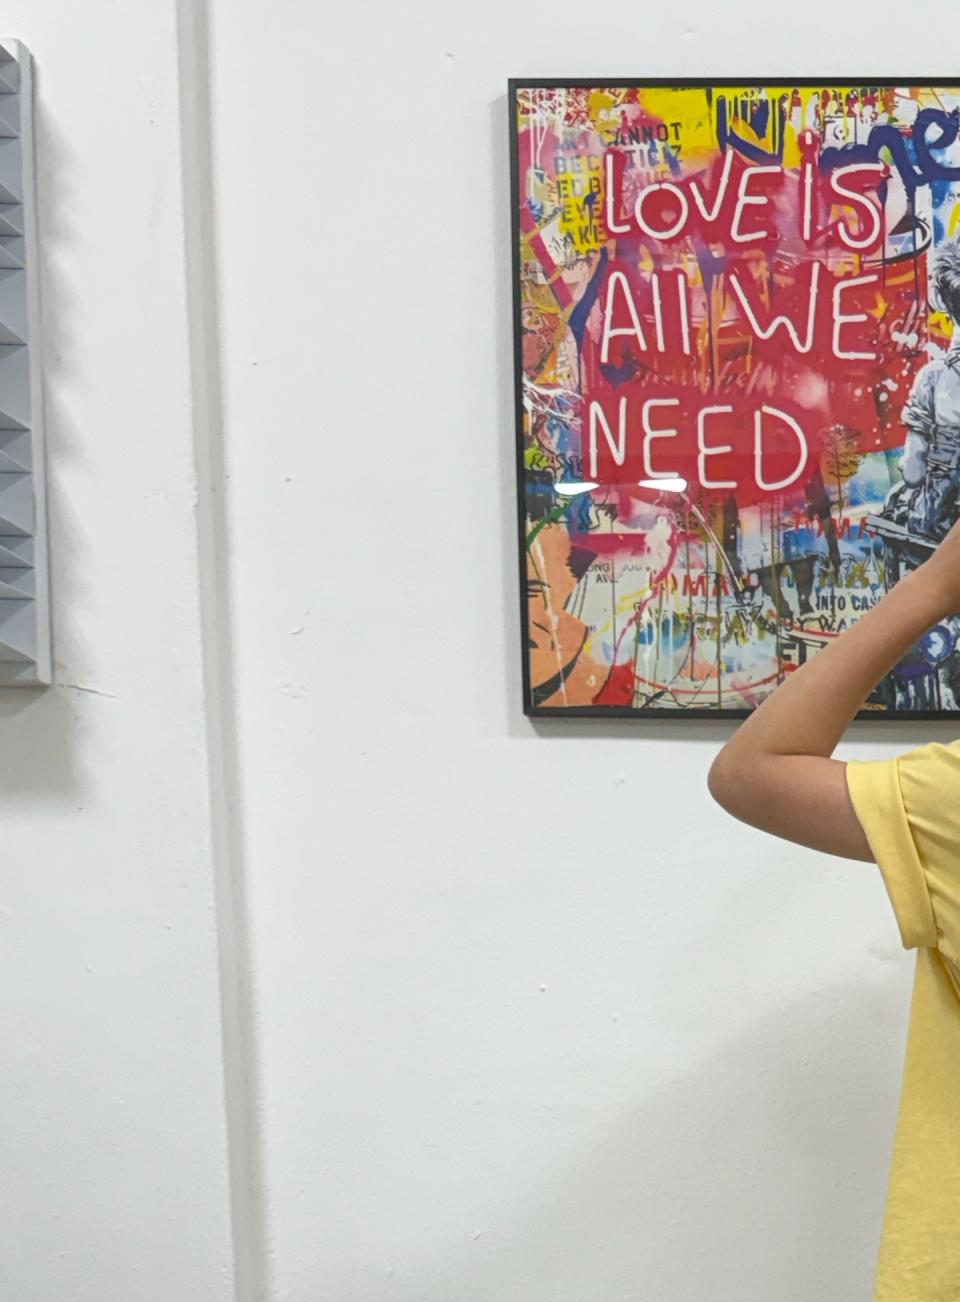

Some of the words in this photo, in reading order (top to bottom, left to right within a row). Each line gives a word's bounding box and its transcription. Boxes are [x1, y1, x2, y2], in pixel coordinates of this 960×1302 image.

[606, 148, 782, 243] LOVE
[803, 133, 885, 249] IS
[729, 261, 879, 361] WE
[588, 396, 808, 491] NEED
